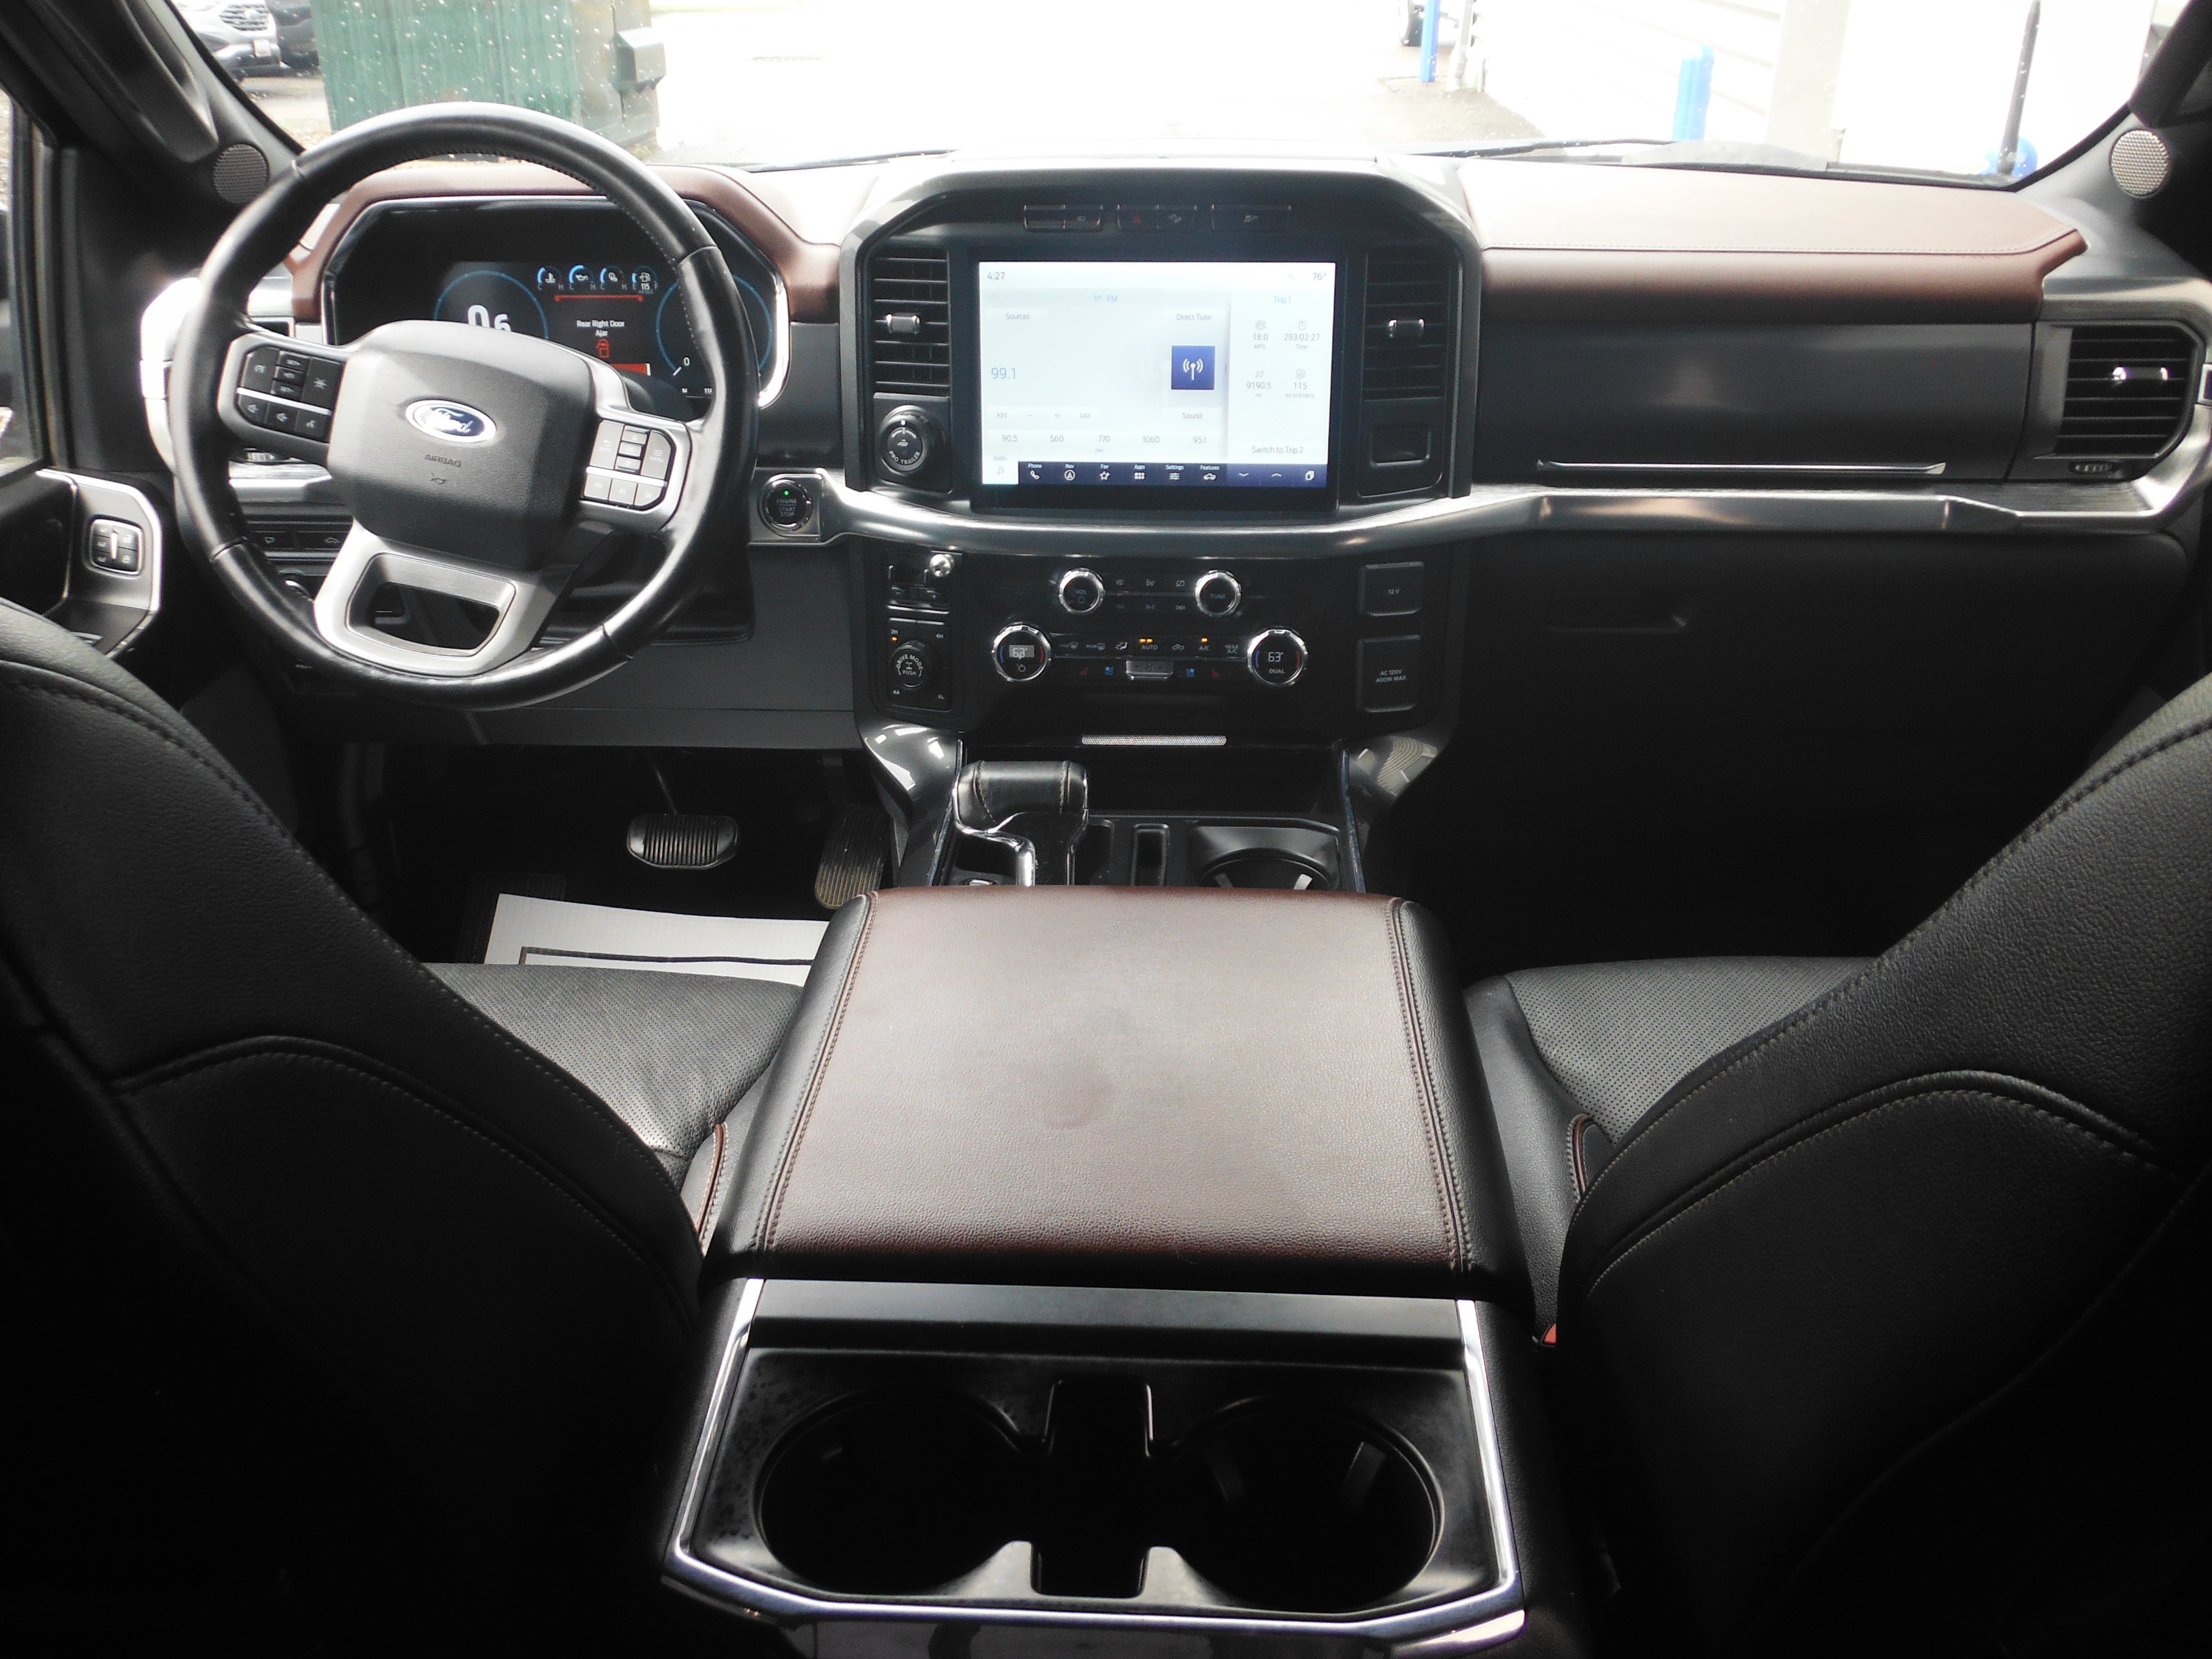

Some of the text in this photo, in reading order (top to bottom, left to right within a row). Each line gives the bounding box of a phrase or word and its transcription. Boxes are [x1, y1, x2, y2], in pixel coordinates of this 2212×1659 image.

[987, 271, 1005, 281] 4:27
[1273, 295, 1286, 304] Trip
[576, 320, 591, 328] Rear
[592, 320, 609, 329] Right
[595, 329, 609, 337] Ajar
[1283, 333, 1320, 341] 293:02:27
[683, 356, 690, 366] 0
[991, 367, 1016, 379] 99.1
[1246, 381, 1271, 390] 9190.5
[1293, 381, 1307, 390] 115
[1002, 434, 1018, 442] 90.5
[1285, 446, 1298, 455] Trip
[424, 453, 462, 468] AIRBAG
[888, 450, 921, 465] PRO TRAILER
[896, 654, 924, 670] DRIVE MODE
